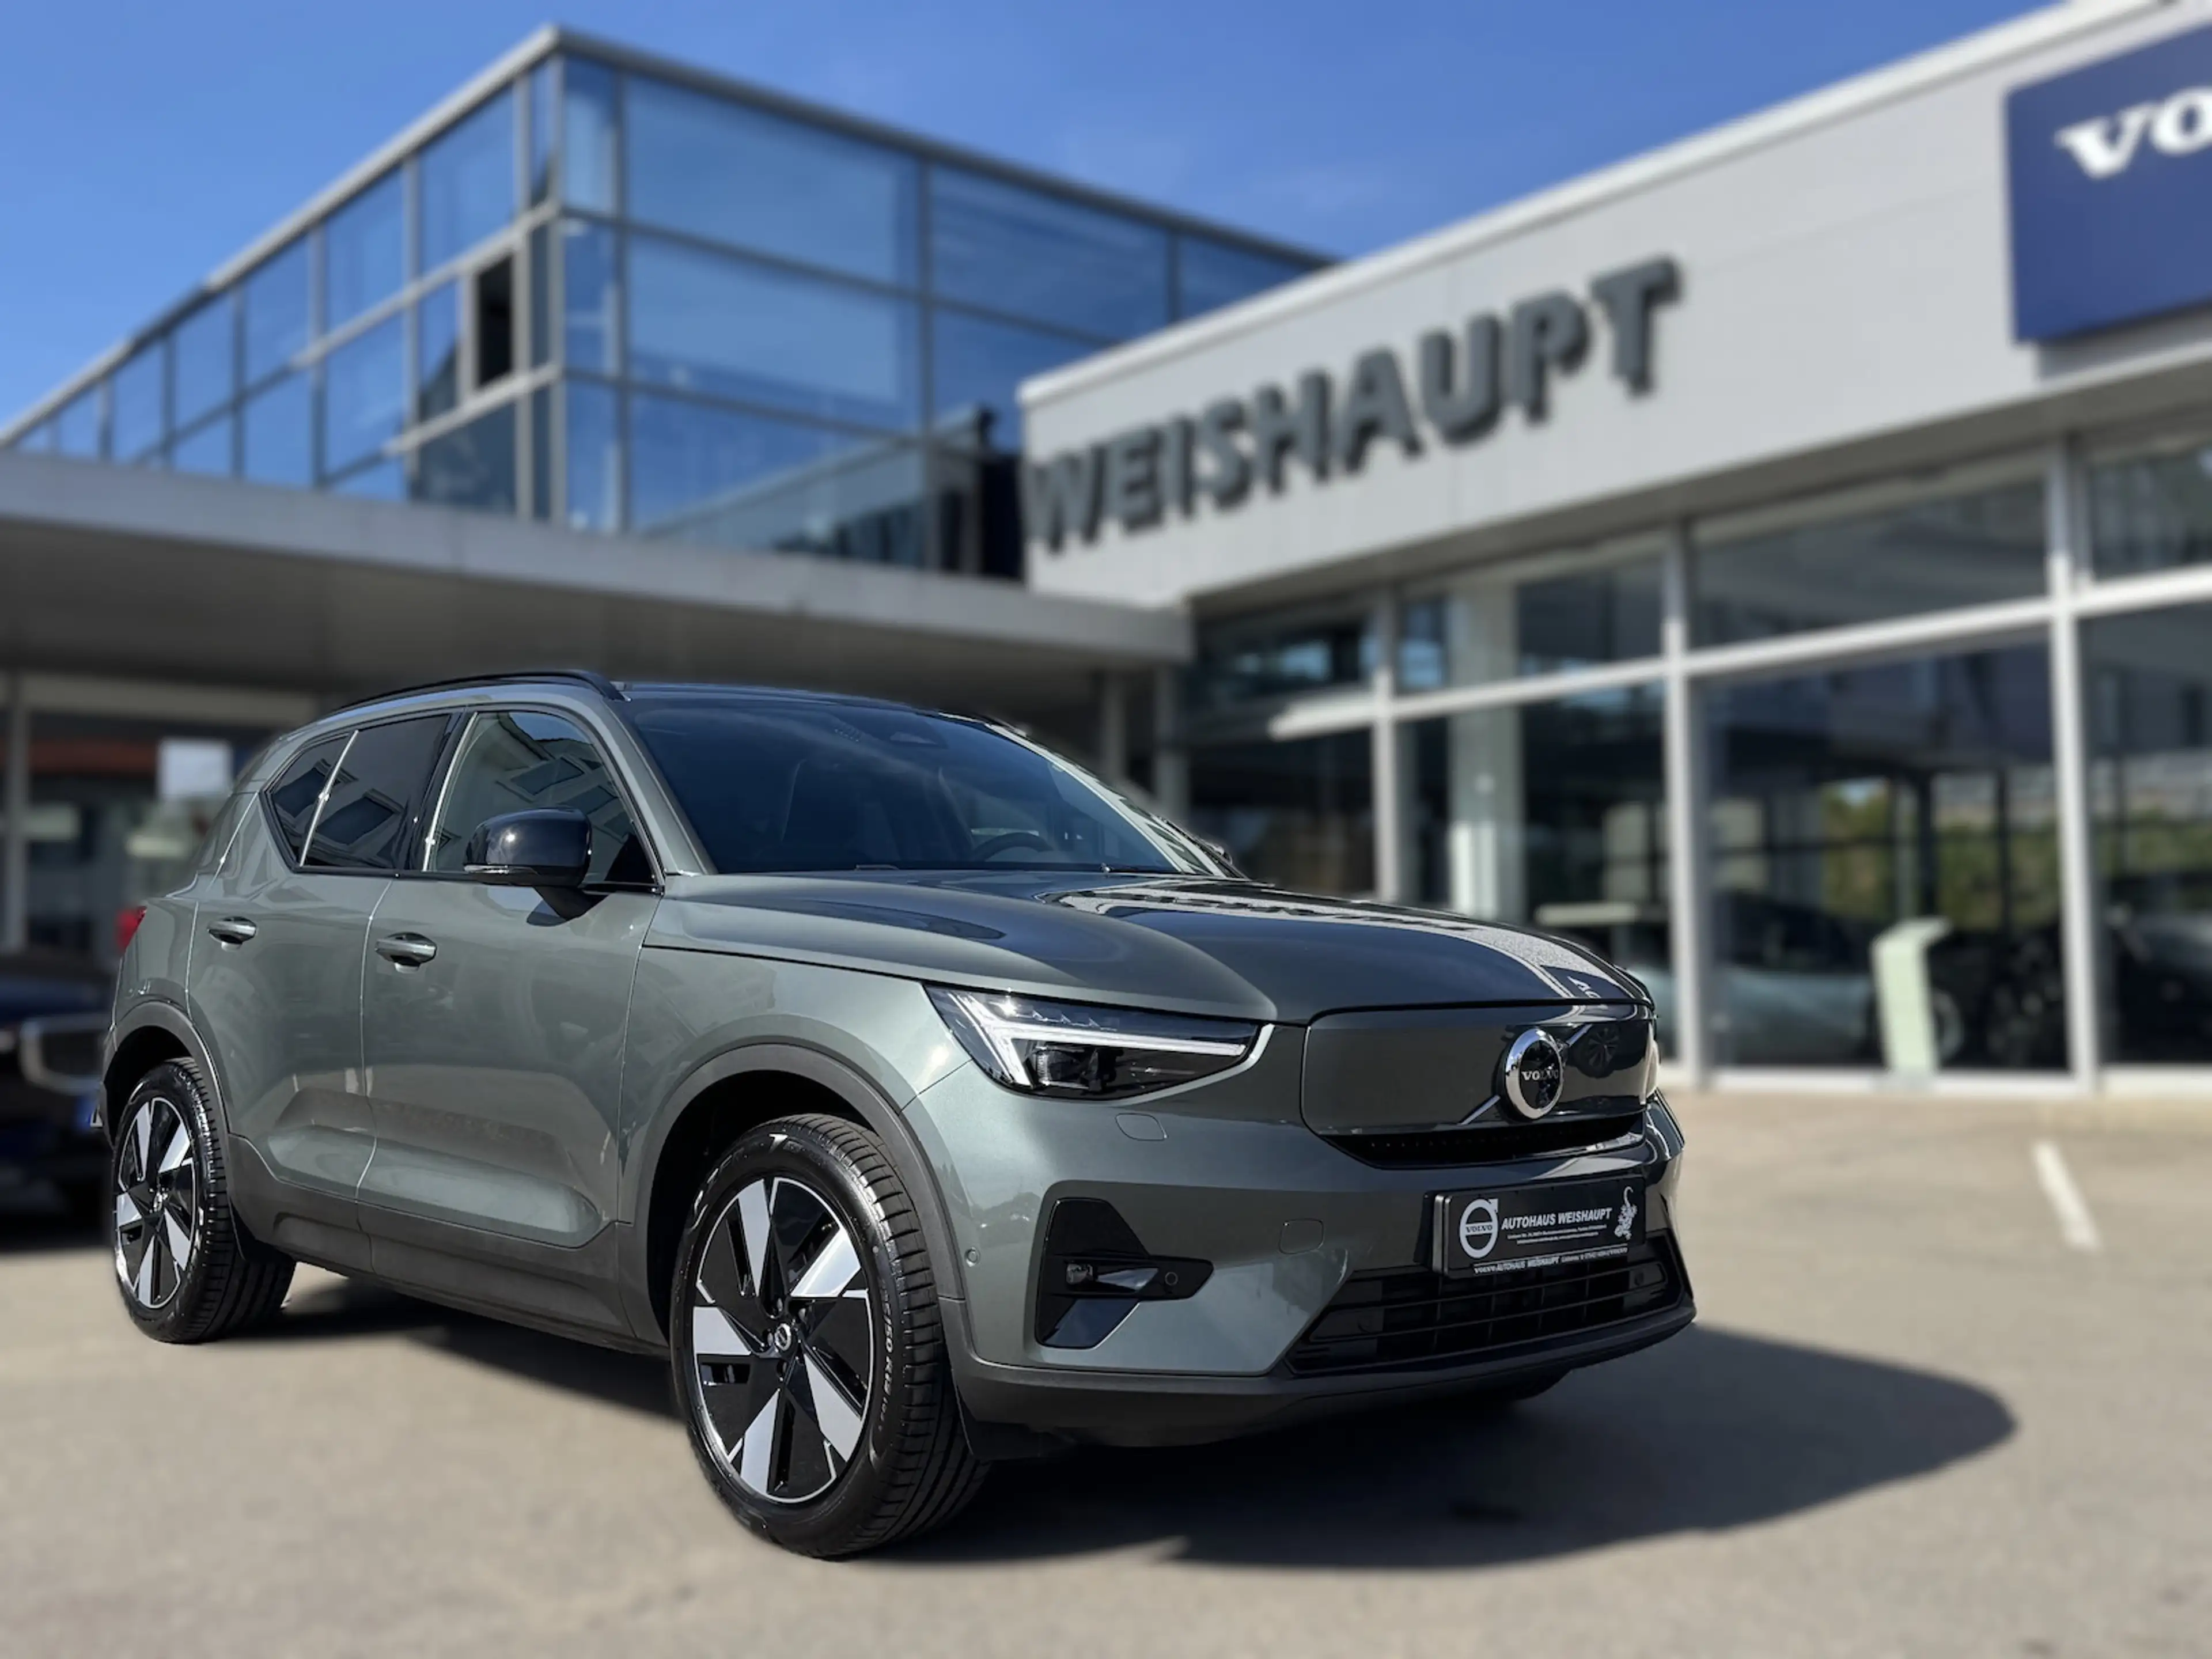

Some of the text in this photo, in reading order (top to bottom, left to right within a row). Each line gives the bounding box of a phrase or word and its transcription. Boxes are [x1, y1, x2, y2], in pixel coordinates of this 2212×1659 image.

[1025, 253, 1682, 552] WEISHAUPT
[1521, 1070, 1558, 1081] VOLVO
[1501, 1208, 1612, 1230] AUTOHAUS WEISHAUPT
[1465, 1225, 1493, 1233] VOLVO
